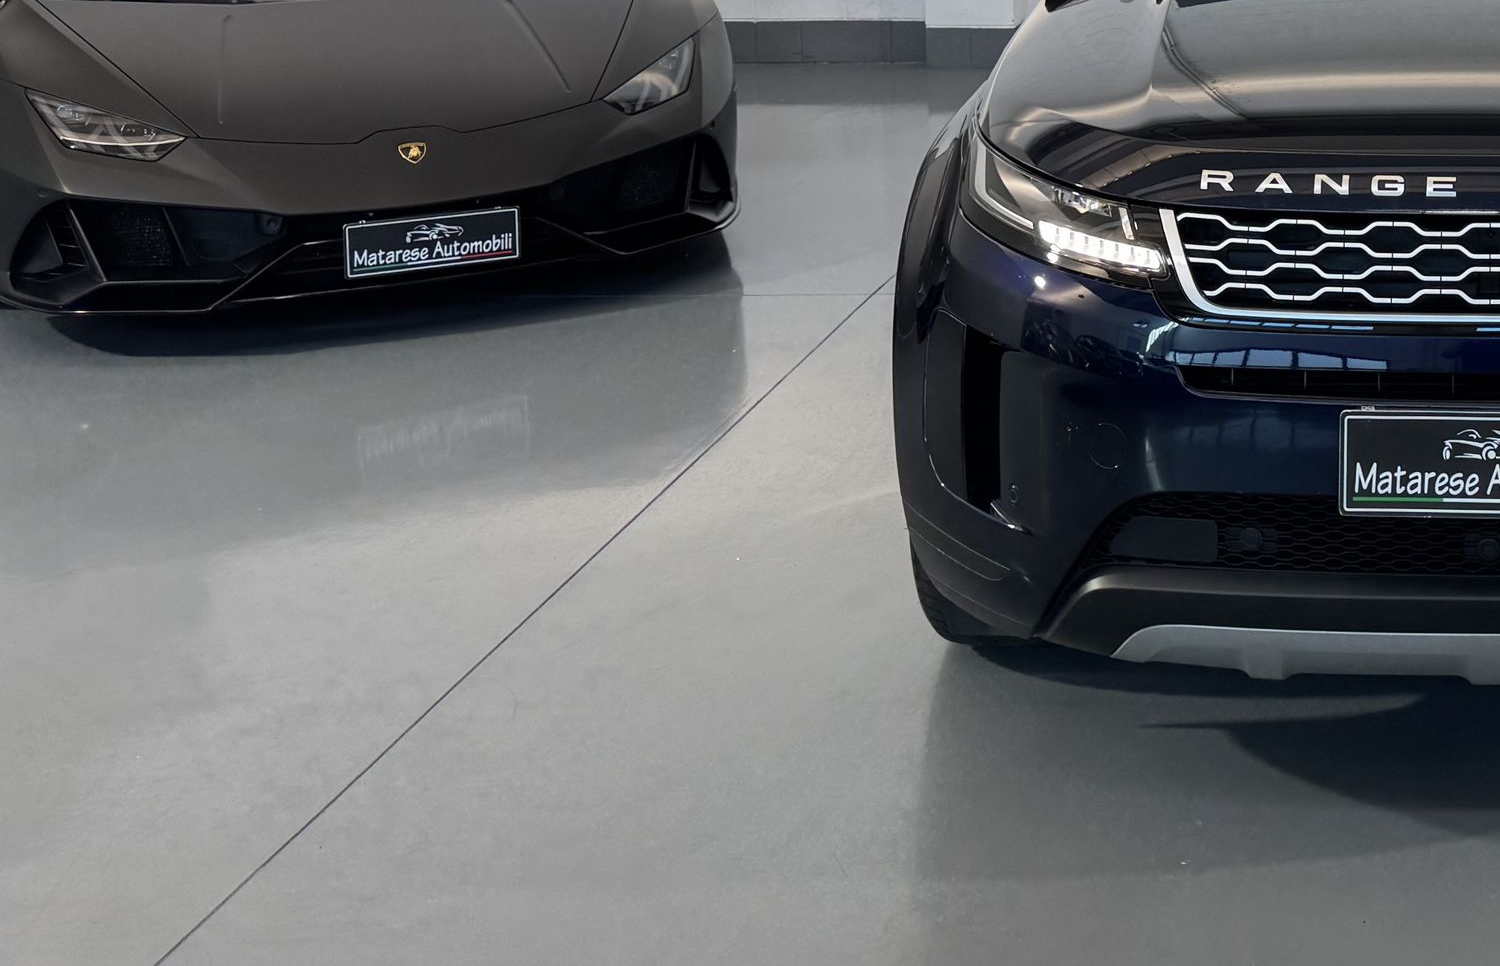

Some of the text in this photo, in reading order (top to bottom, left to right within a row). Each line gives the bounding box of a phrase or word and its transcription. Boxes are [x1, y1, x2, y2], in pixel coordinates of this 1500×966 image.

[1199, 168, 1457, 198] RANGE
[353, 232, 513, 268] Matarese Automobili
[1354, 462, 1480, 497] Matarese
